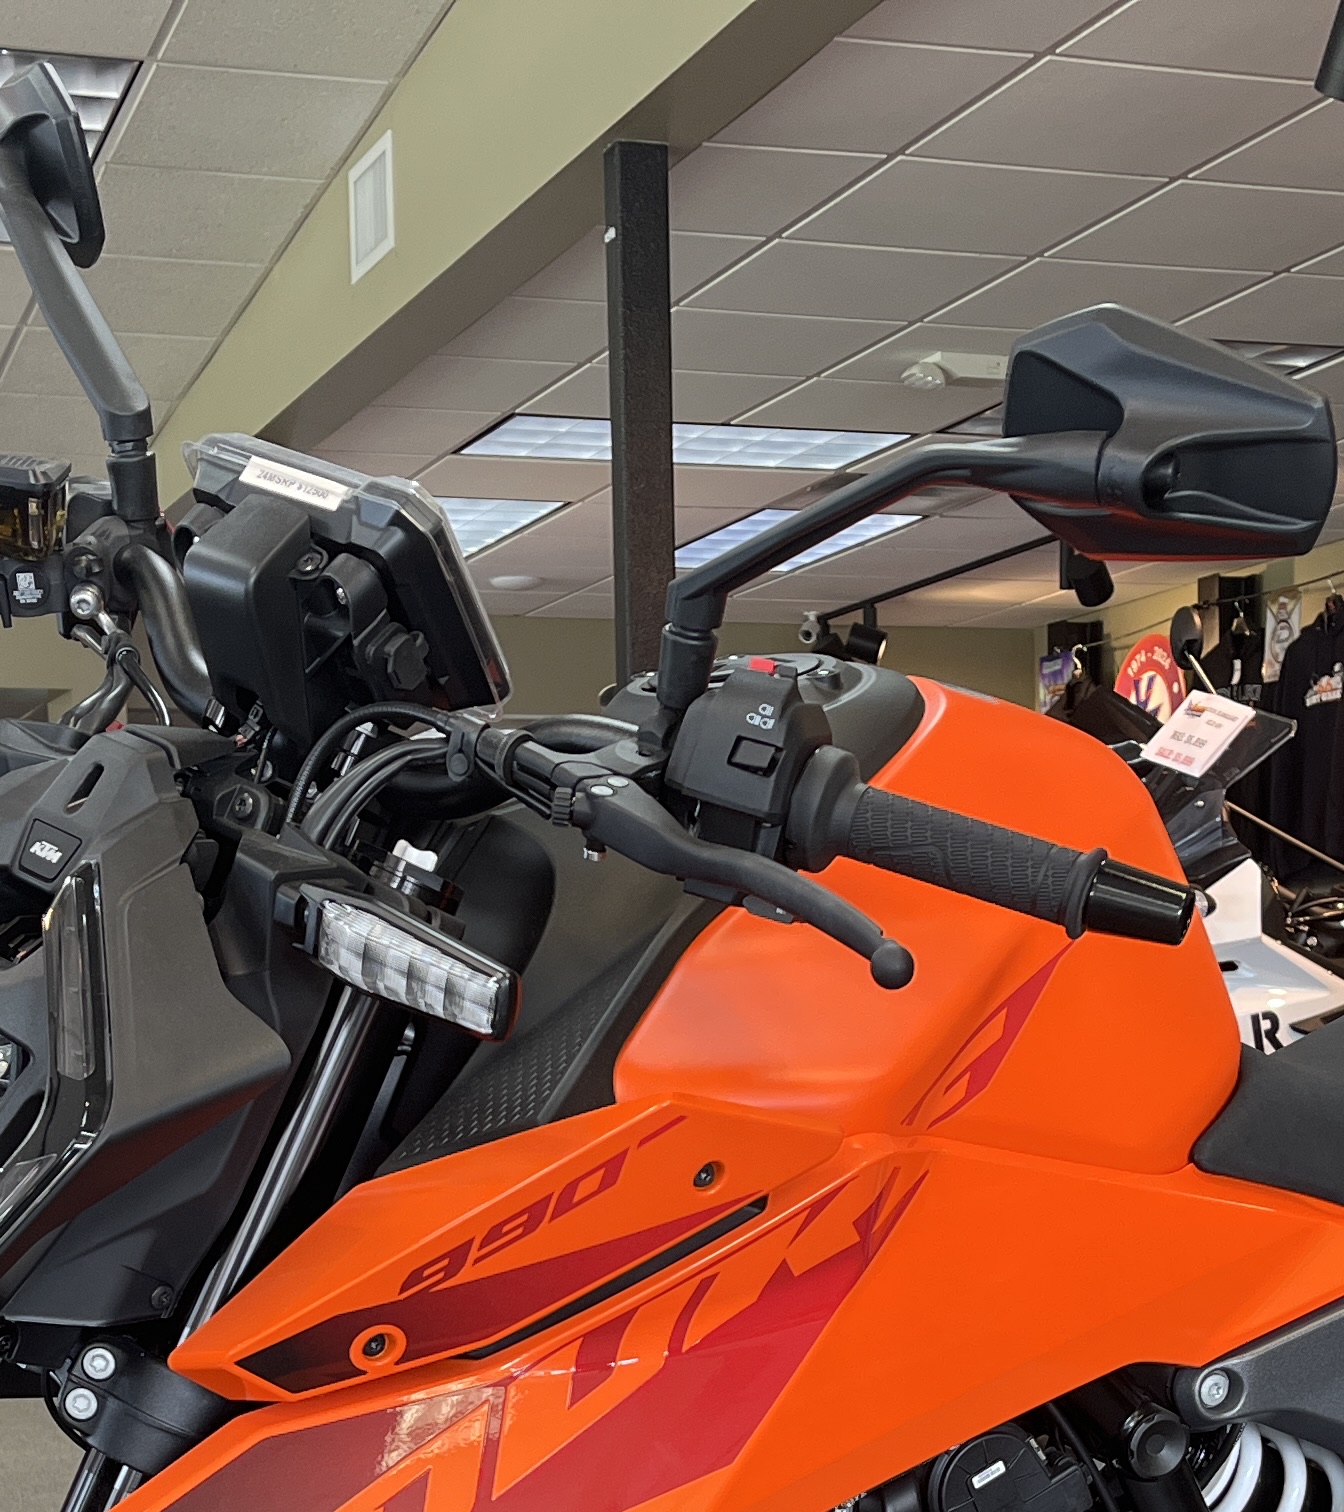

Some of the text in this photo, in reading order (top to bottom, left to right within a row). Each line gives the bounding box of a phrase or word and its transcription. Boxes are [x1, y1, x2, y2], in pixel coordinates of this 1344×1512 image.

[29, 840, 63, 864] KTM
[1250, 1010, 1284, 1053] R
[397, 1141, 631, 1301] 990
